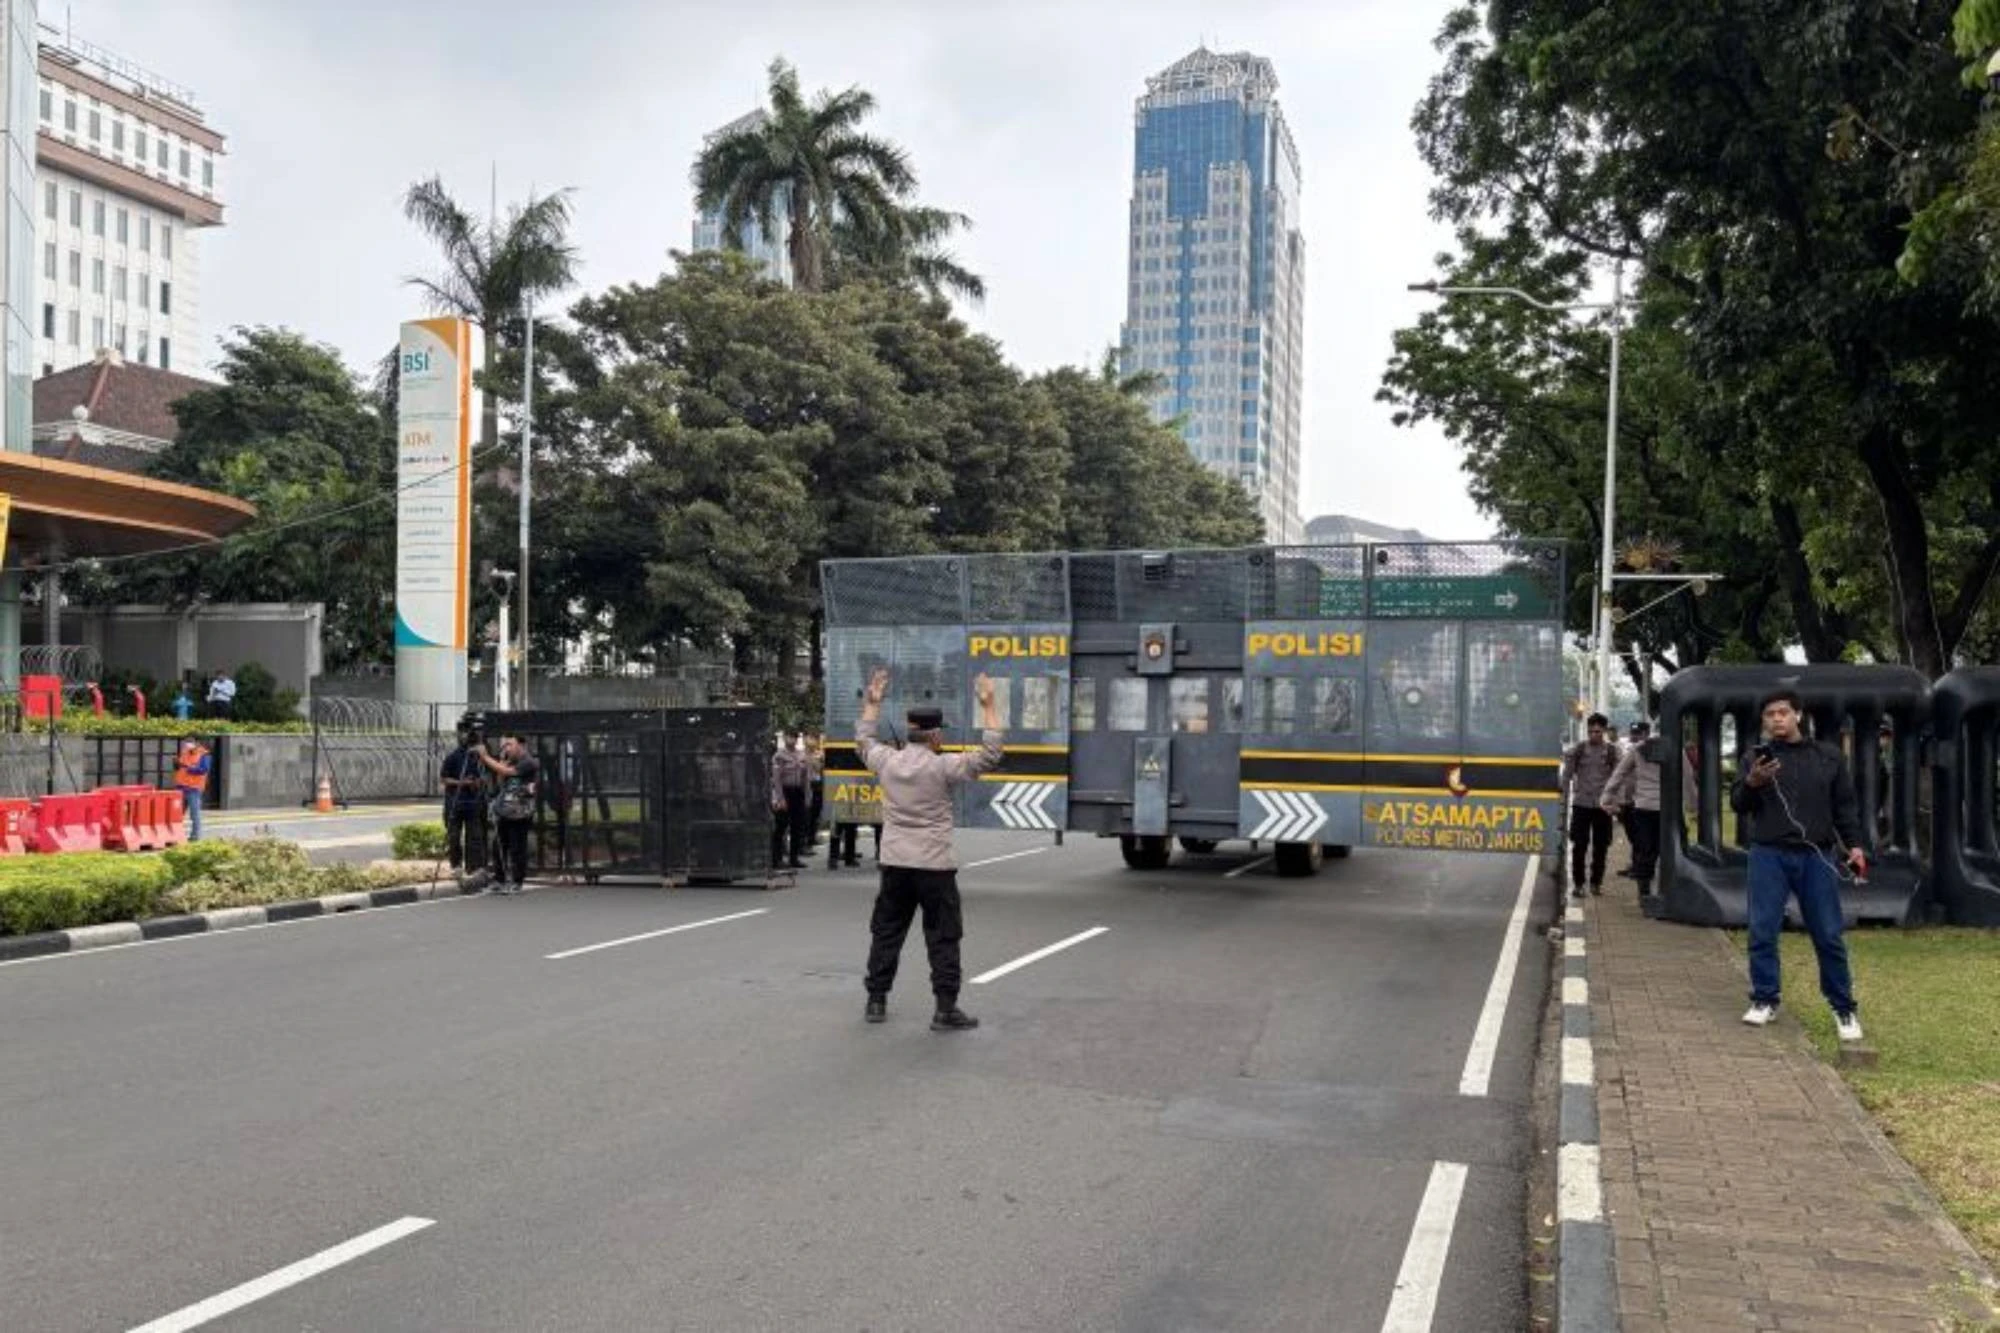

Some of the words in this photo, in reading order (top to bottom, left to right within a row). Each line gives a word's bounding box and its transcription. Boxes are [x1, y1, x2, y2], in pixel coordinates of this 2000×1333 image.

[403, 352, 429, 373] BSI
[969, 635, 1067, 657] POLISI
[1249, 633, 1363, 657] POLISI
[833, 784, 882, 804] ATSA
